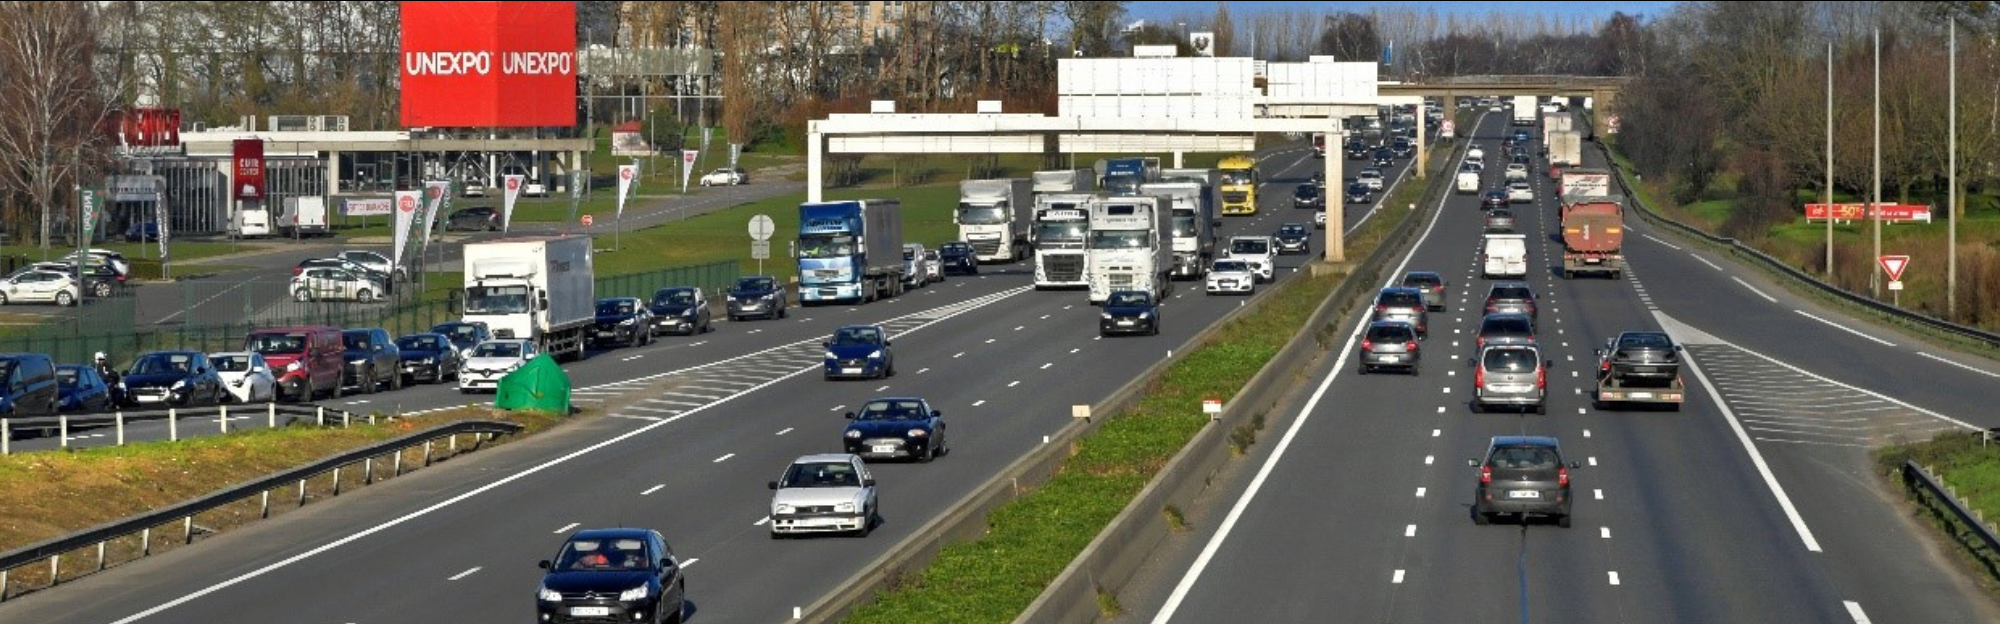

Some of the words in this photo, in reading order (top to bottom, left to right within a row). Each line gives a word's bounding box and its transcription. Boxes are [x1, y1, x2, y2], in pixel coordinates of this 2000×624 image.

[406, 52, 490, 75] UNEXPO
[502, 52, 570, 75] UNEXPO
[240, 158, 259, 167] CUIR
